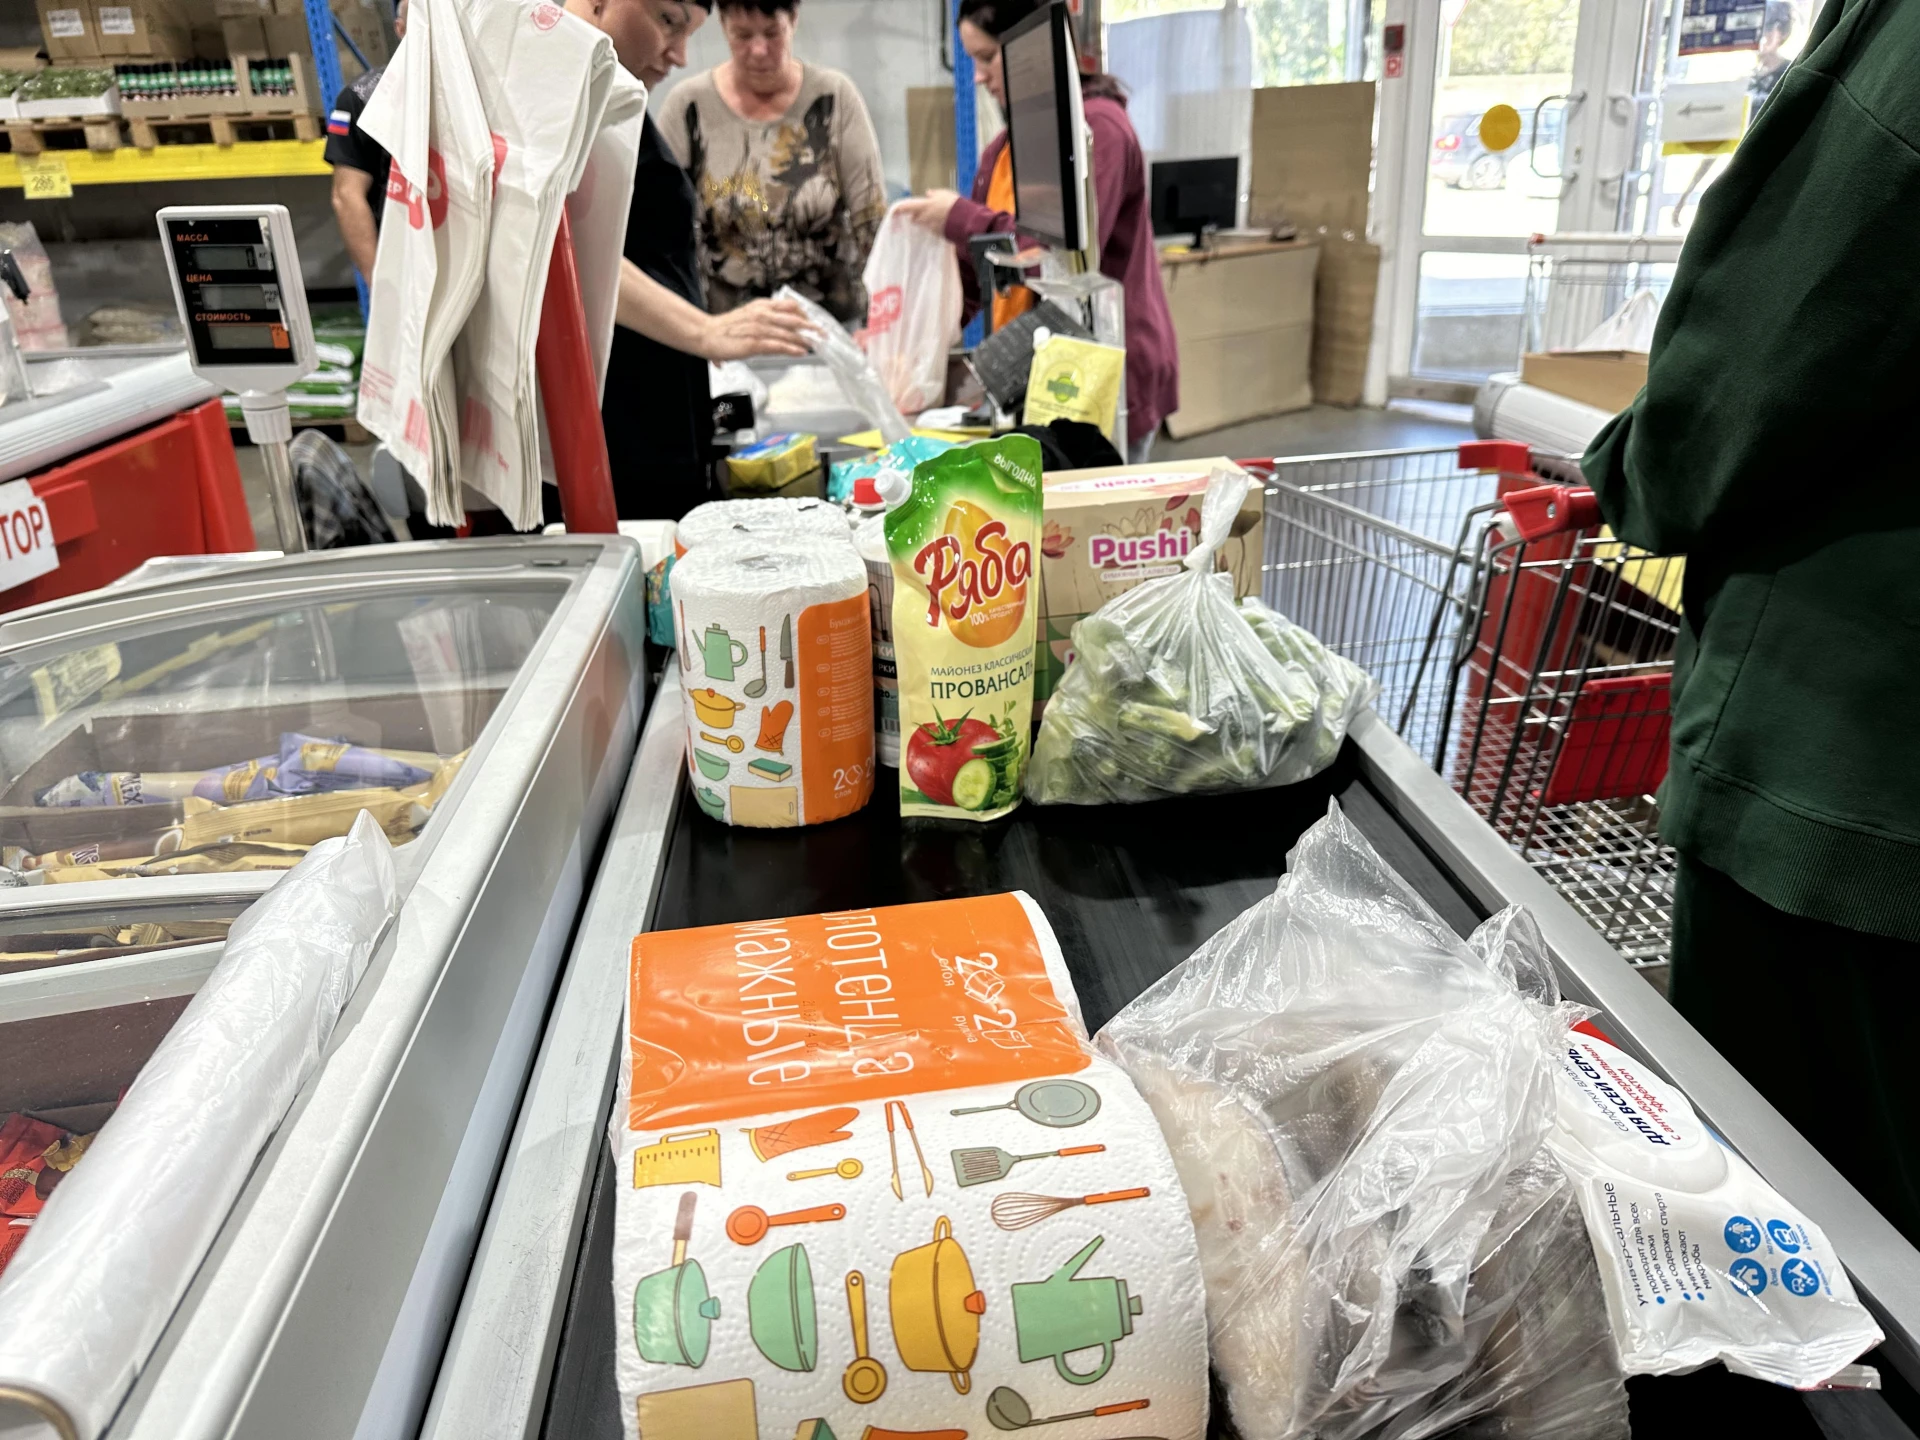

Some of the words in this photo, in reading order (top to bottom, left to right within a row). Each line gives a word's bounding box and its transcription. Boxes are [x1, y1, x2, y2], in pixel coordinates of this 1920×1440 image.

[177, 233, 209, 242] МАССА
[186, 273, 213, 283] ЦЕНА
[195, 313, 251, 322] СТОИМОСТЬ
[993, 453, 1037, 488] ВЫГОДНО
[1091, 530, 1189, 566] Pushi
[913, 520, 1032, 628] Ряба
[931, 664, 982, 676] МАЙОНЕЗ
[833, 768, 845, 791] 2
[834, 788, 852, 799] слоя
[954, 951, 998, 974] 2
[972, 1008, 1018, 1031] 2
[1581, 1043, 1675, 1134] антибактериальным
[1594, 1082, 1638, 1115] ВСЕЙ
[1617, 1068, 1669, 1114] эффектом
[1583, 1088, 1629, 1132] салфетки
[1628, 1116, 1672, 1146] ДЛЯ
[1629, 1201, 1641, 1225] всех
[1654, 1192, 1669, 1226] спирта
[1634, 1226, 1645, 1246] для
[1647, 1234, 1659, 1262] кожи
[1661, 1227, 1679, 1277] содержат
[1678, 1229, 1703, 1292] уничтожают
[1691, 1243, 1713, 1290] микробы
[1637, 1246, 1661, 1295] подходят
[1653, 1263, 1673, 1293] типов
[1675, 1278, 1687, 1291] не
